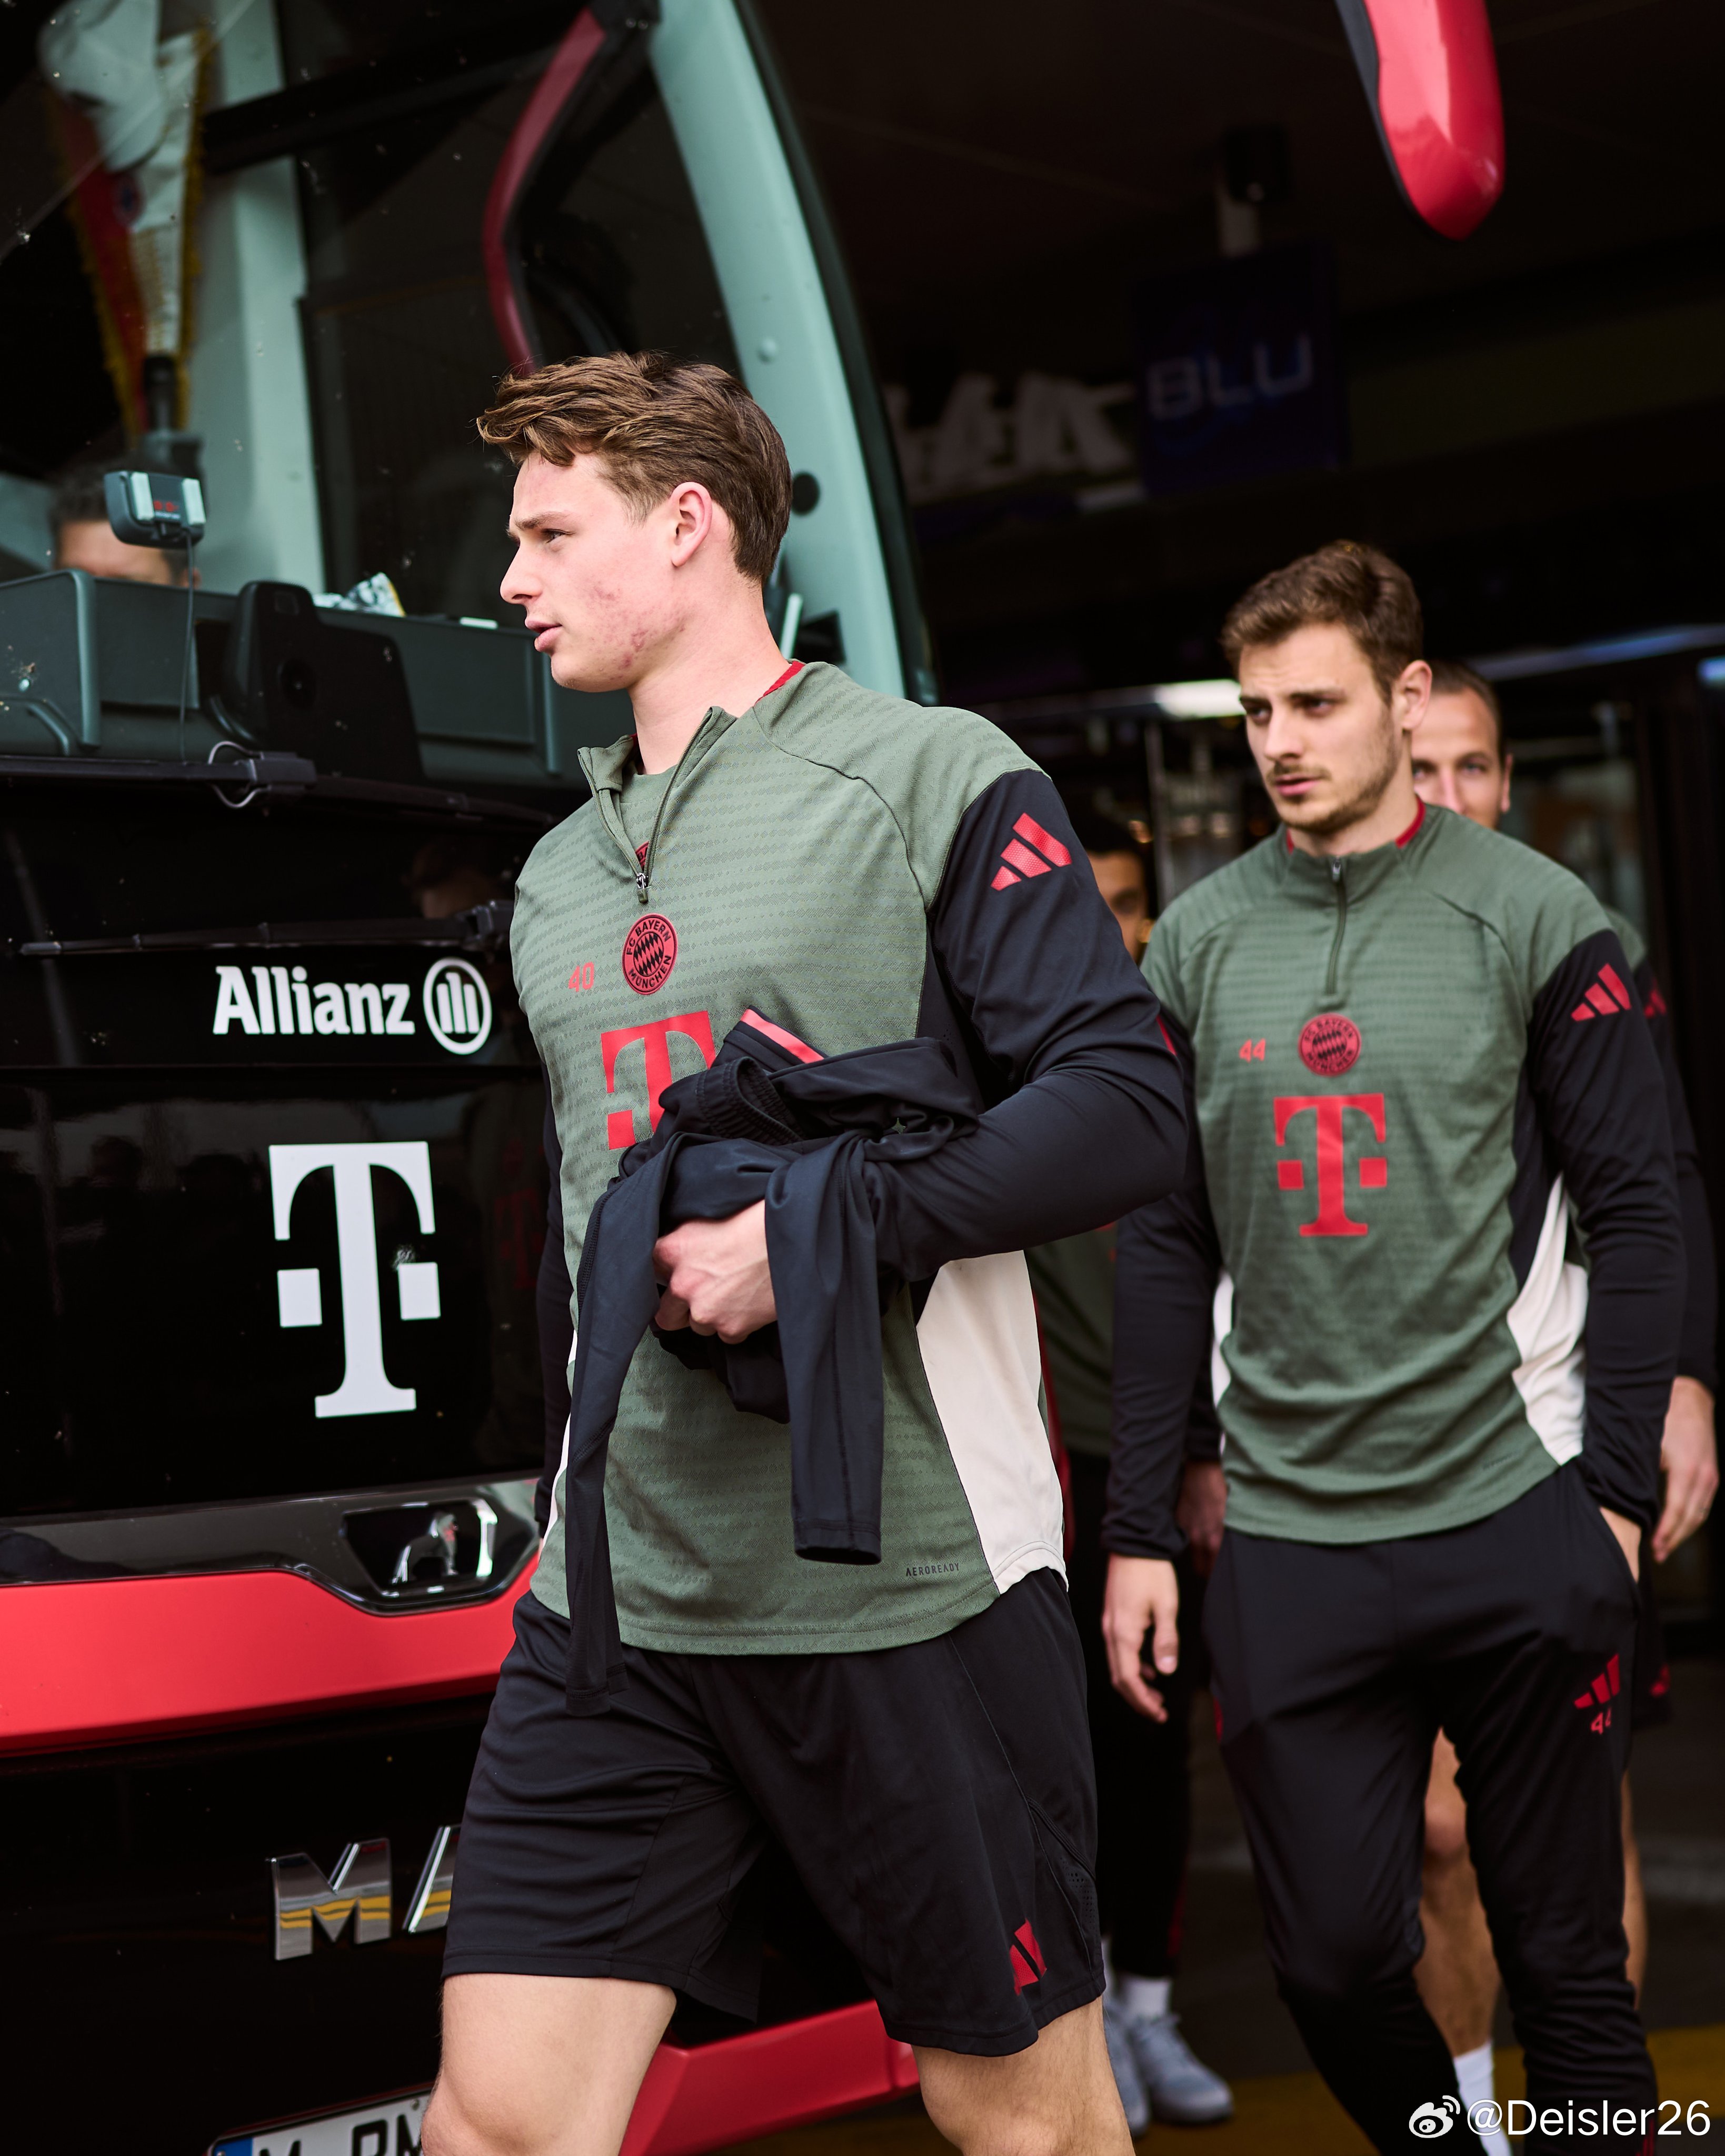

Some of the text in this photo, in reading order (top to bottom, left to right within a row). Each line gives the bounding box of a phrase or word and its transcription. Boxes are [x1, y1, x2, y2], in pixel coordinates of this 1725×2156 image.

[1146, 333, 1315, 422] BLU
[626, 920, 671, 955] FC BAYERN
[212, 965, 416, 1035] Allianz
[568, 961, 594, 993] 40
[1239, 1038, 1265, 1063] 44
[1273, 1092, 1387, 1236] T
[268, 1141, 441, 1419] T
[906, 1562, 959, 1577] AEROREADY
